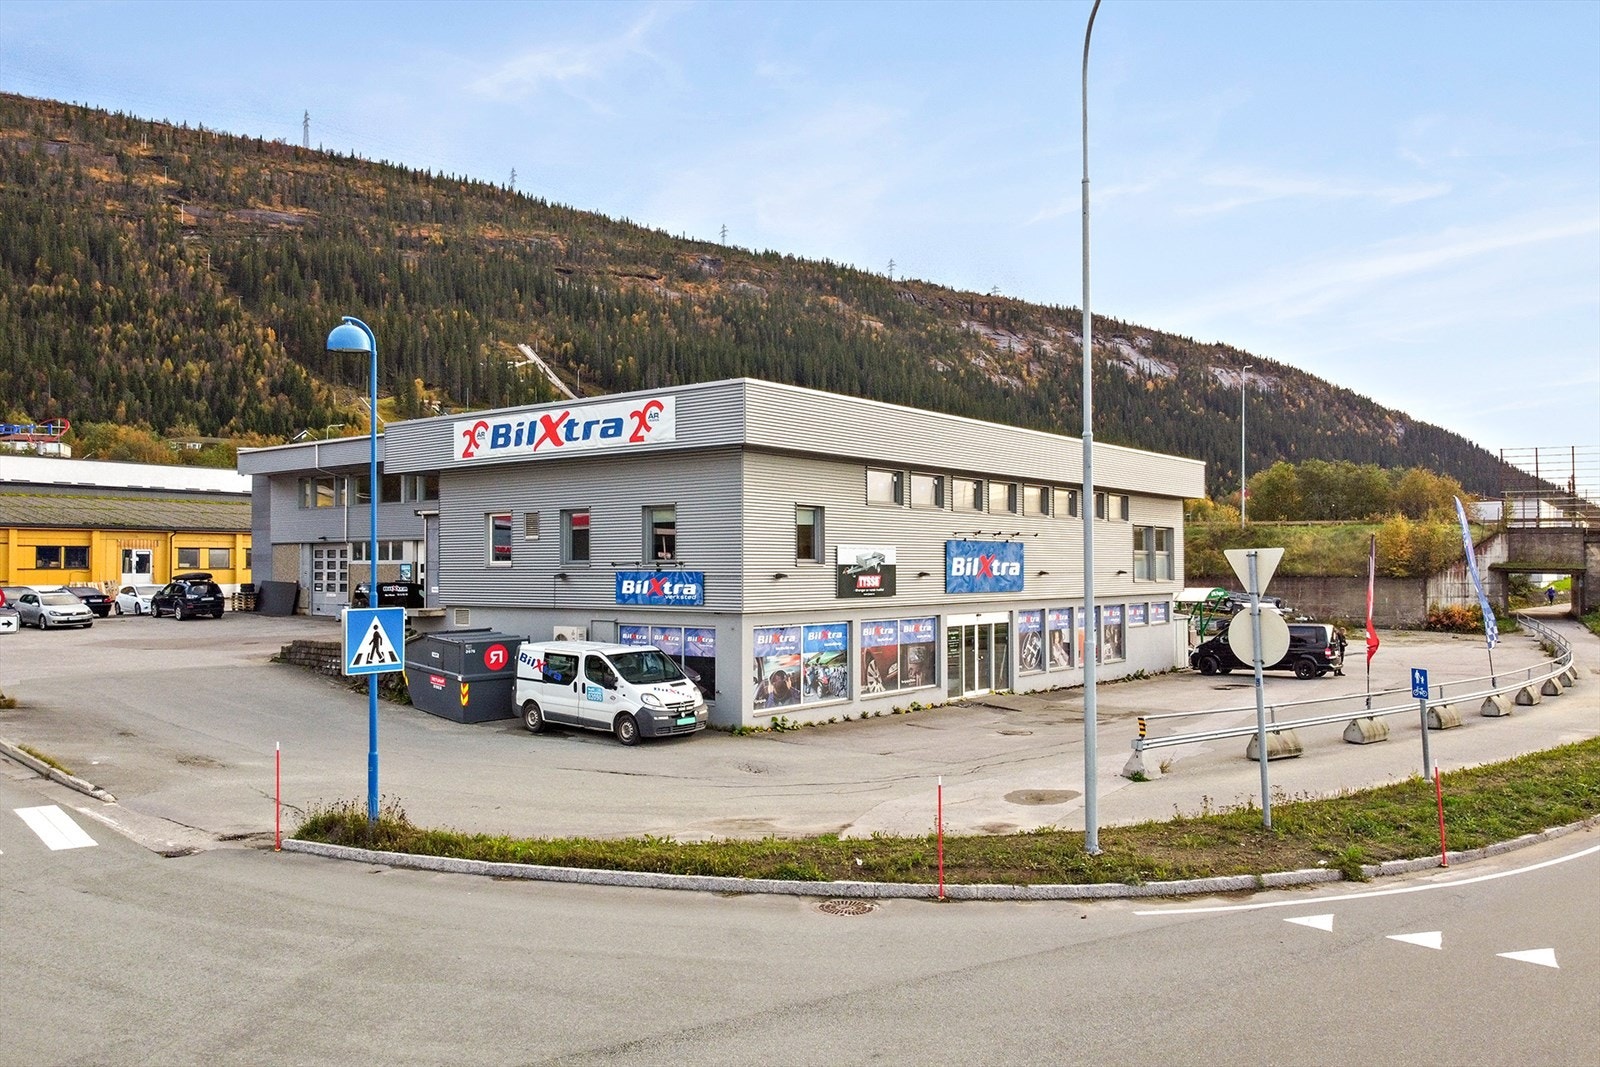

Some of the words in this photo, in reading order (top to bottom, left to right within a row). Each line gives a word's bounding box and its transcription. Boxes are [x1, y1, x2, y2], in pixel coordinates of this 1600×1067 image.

[490, 411, 624, 452] BilXtra
[951, 554, 1020, 578] BilXtra
[621, 577, 697, 597] BilXtra
[862, 626, 894, 636] BilXtra
[903, 624, 932, 633] BilXtra
[622, 632, 647, 640] BilXtra
[687, 635, 714, 643] BilXtra
[757, 633, 796, 644] BilXtra
[808, 630, 843, 640] BilXtra
[520, 652, 562, 682] BilXtra
